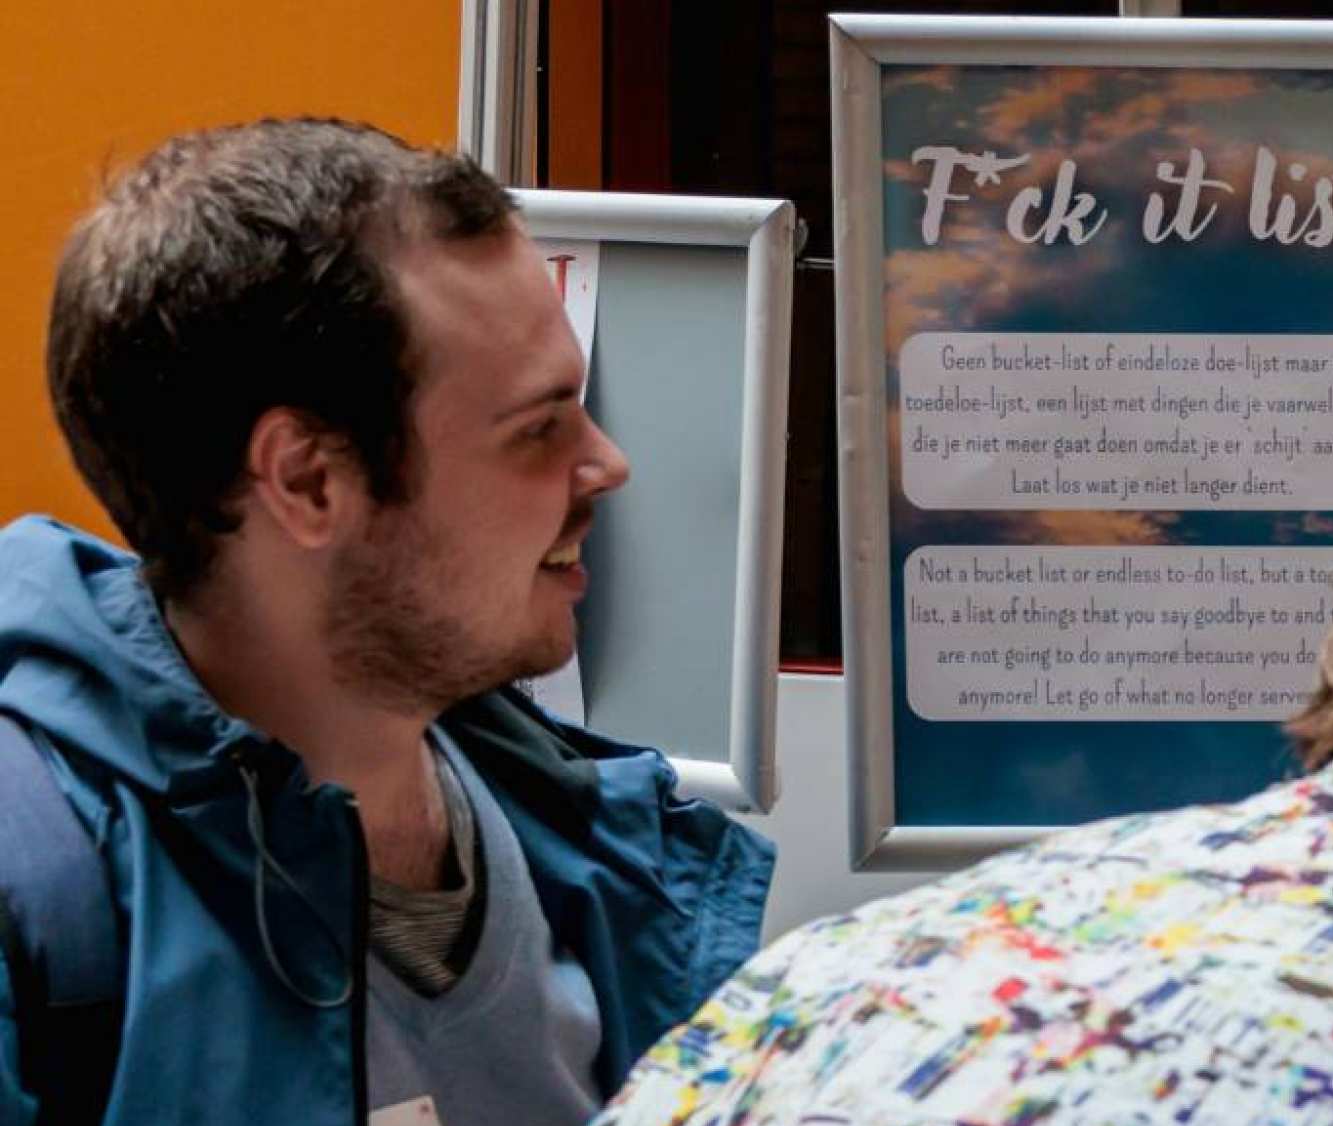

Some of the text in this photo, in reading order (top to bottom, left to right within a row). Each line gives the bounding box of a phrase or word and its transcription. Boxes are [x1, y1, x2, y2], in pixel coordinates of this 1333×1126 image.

[1143, 146, 1236, 244] it
[942, 343, 986, 372] Geen
[991, 343, 1088, 372] bucket-list
[1095, 342, 1115, 371] of
[1118, 343, 1200, 373] eindeloze
[1205, 343, 1280, 380] doe-lijst
[1285, 354, 1328, 373] maar
[1036, 396, 1068, 412] een
[1073, 385, 1109, 420] lijst
[1112, 394, 1145, 413] met
[1151, 385, 1209, 420] dingen
[1213, 386, 1241, 413] die
[1244, 394, 1261, 420] je
[1266, 386, 1333, 413] vaarwel
[912, 424, 939, 454] die
[942, 436, 961, 460] je
[965, 434, 1000, 453] niet
[1004, 437, 1048, 453] meer
[1054, 437, 1092, 460] gaat
[1096, 425, 1139, 454] doen
[1143, 426, 1198, 454] omdat
[1201, 436, 1220, 460] je
[1224, 438, 1242, 454] er
[1011, 466, 1294, 501] Laat los wat je niet langer dient.
[919, 556, 953, 584] Not
[957, 568, 968, 584] a
[973, 556, 1033, 584] bucket
[1039, 556, 1066, 584] list
[1072, 568, 1090, 584] or
[1095, 556, 1161, 584] endless
[1167, 556, 1215, 584] to-do
[1220, 556, 1256, 586] list,
[1260, 557, 1289, 584] but
[1293, 568, 1305, 584] a
[911, 596, 944, 625] list,
[951, 609, 962, 623] a
[967, 597, 996, 623] list
[1000, 595, 1020, 623] of
[1023, 597, 1077, 630] things
[1082, 597, 1119, 623] that
[1124, 609, 1155, 629] you
[1161, 609, 1189, 630] say
[1195, 597, 1265, 630] goodbye
[1271, 605, 1289, 623] to
[1294, 597, 1326, 623] and
[937, 649, 966, 664] are
[970, 647, 1000, 664] not
[1005, 648, 1051, 670] going
[1056, 647, 1074, 664] to
[1079, 636, 1100, 664] do
[1105, 648, 1179, 670] anymore
[1183, 637, 1256, 664] because
[1260, 649, 1290, 670] you
[958, 679, 1038, 711] anymore!
[1046, 680, 1073, 705] Let
[1079, 690, 1099, 712] go
[1104, 678, 1123, 705] of
[1126, 680, 1170, 705] what
[1175, 690, 1194, 705] no
[1200, 679, 1253, 711] longer
